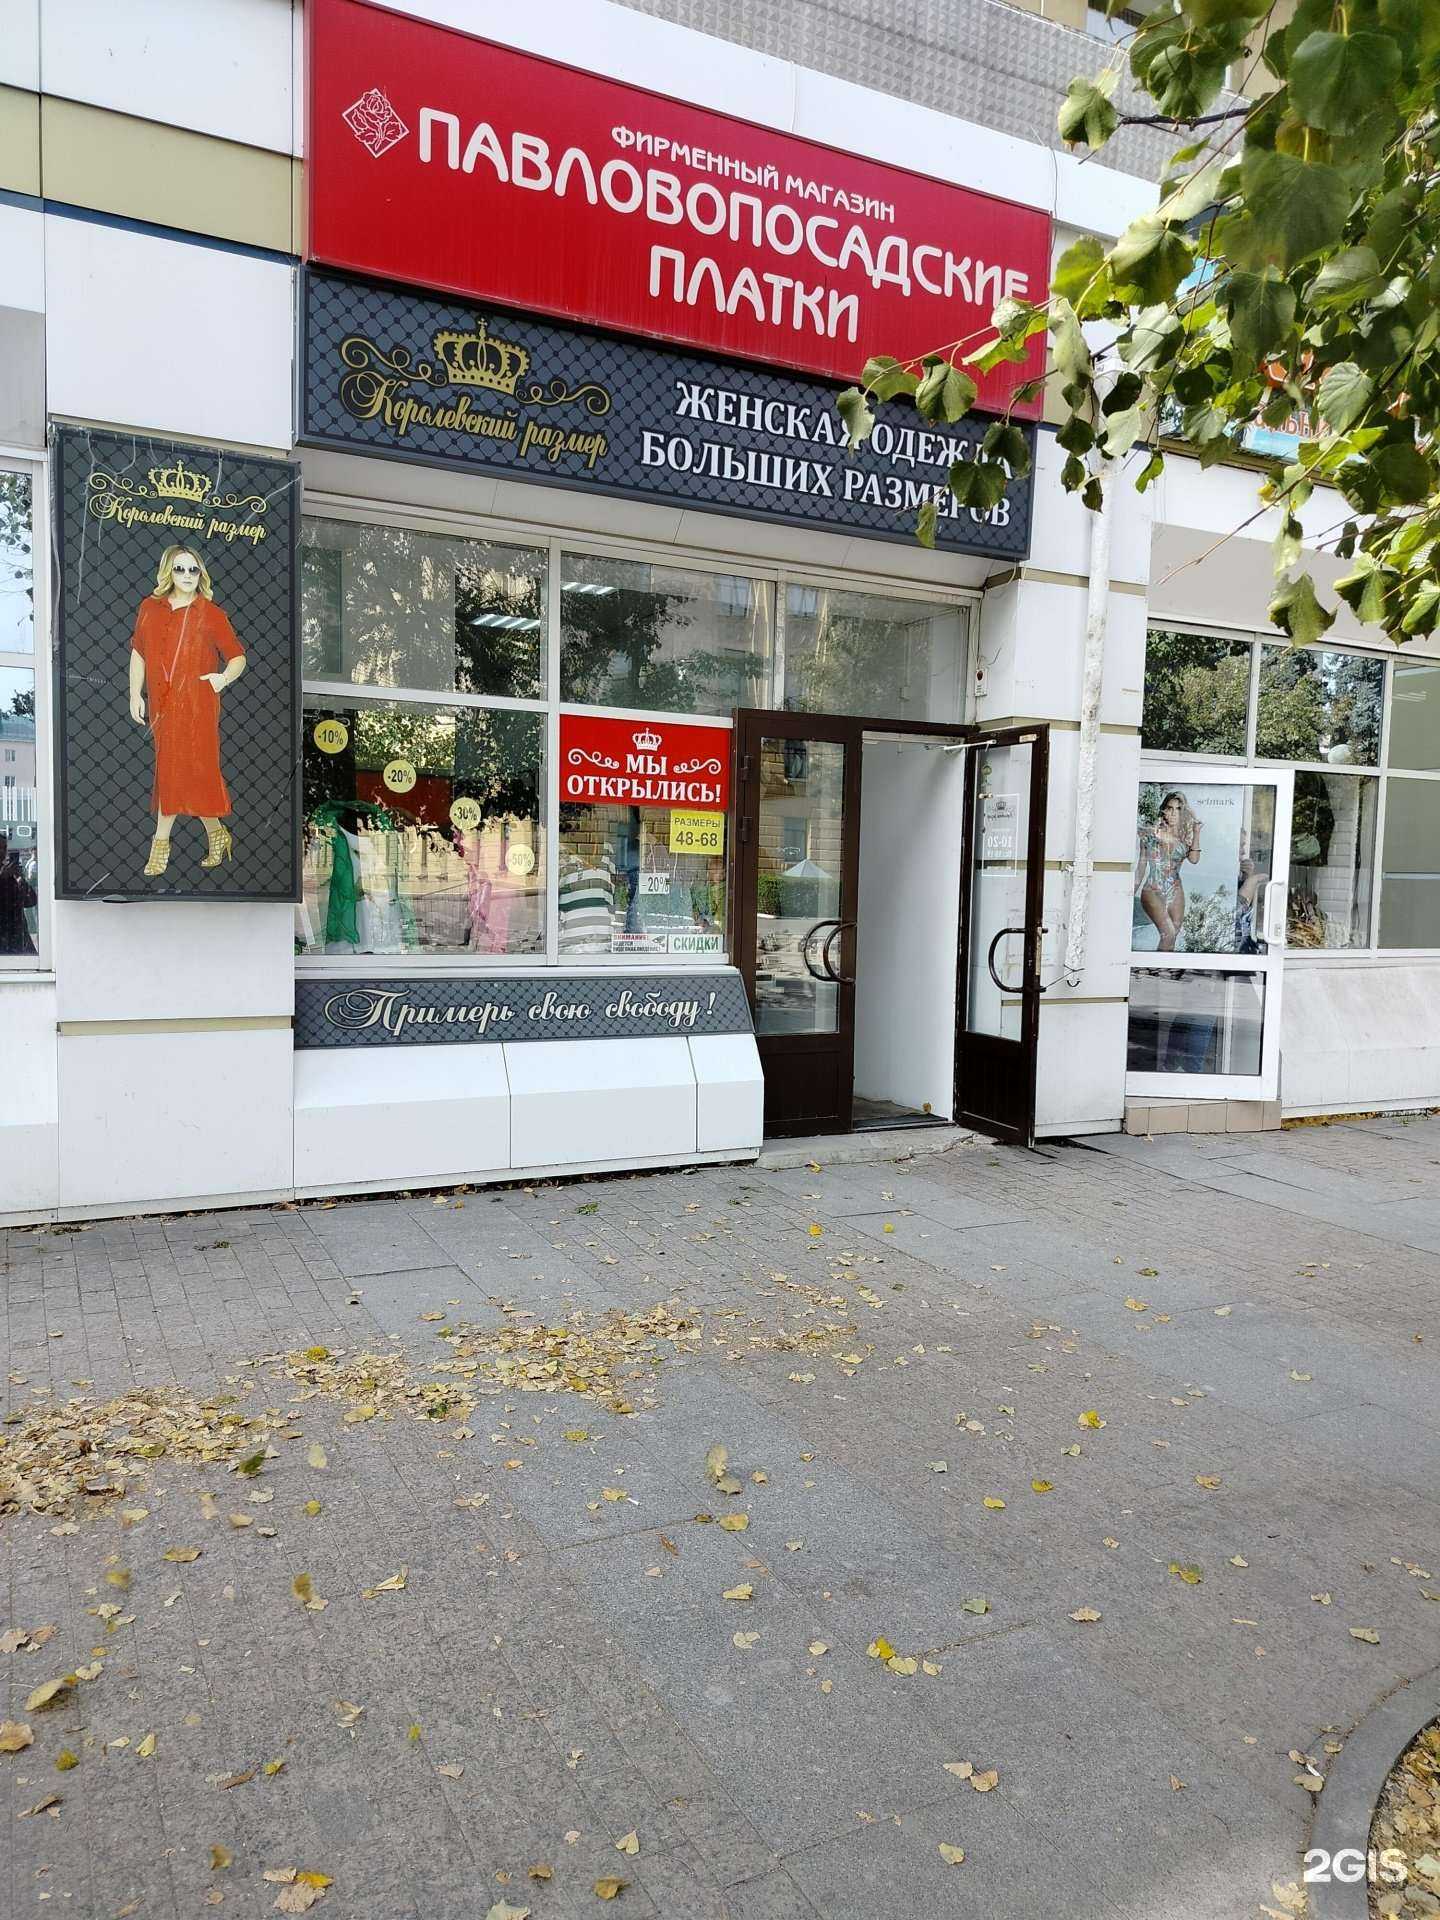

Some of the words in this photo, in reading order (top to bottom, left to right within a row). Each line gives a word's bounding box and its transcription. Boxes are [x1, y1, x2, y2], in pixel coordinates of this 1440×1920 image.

[611, 126, 779, 190] ФИРМЕННЫЙ
[785, 175, 895, 223] МАГАЗИН
[418, 107, 1029, 306] ПАВЛОВОПОСАДСКИЕ
[650, 246, 859, 343] ПЛАТКИ
[341, 371, 517, 440] Королевский
[520, 418, 608, 468] размер
[641, 431, 834, 498] БОЛЬШИХ
[89, 493, 205, 529] Королевский
[207, 517, 266, 546] размер
[318, 729, 344, 745] -10%
[388, 770, 412, 784] -20%
[625, 754, 667, 775] МЫ
[567, 775, 721, 803] ОТКРЫЛИСЬ!
[674, 817, 721, 828] РАЗМЕРЫ
[676, 831, 718, 847] 48-68
[673, 936, 719, 953] СКИДКИ
[325, 988, 515, 1036] Примерь
[528, 991, 592, 1021] свою
